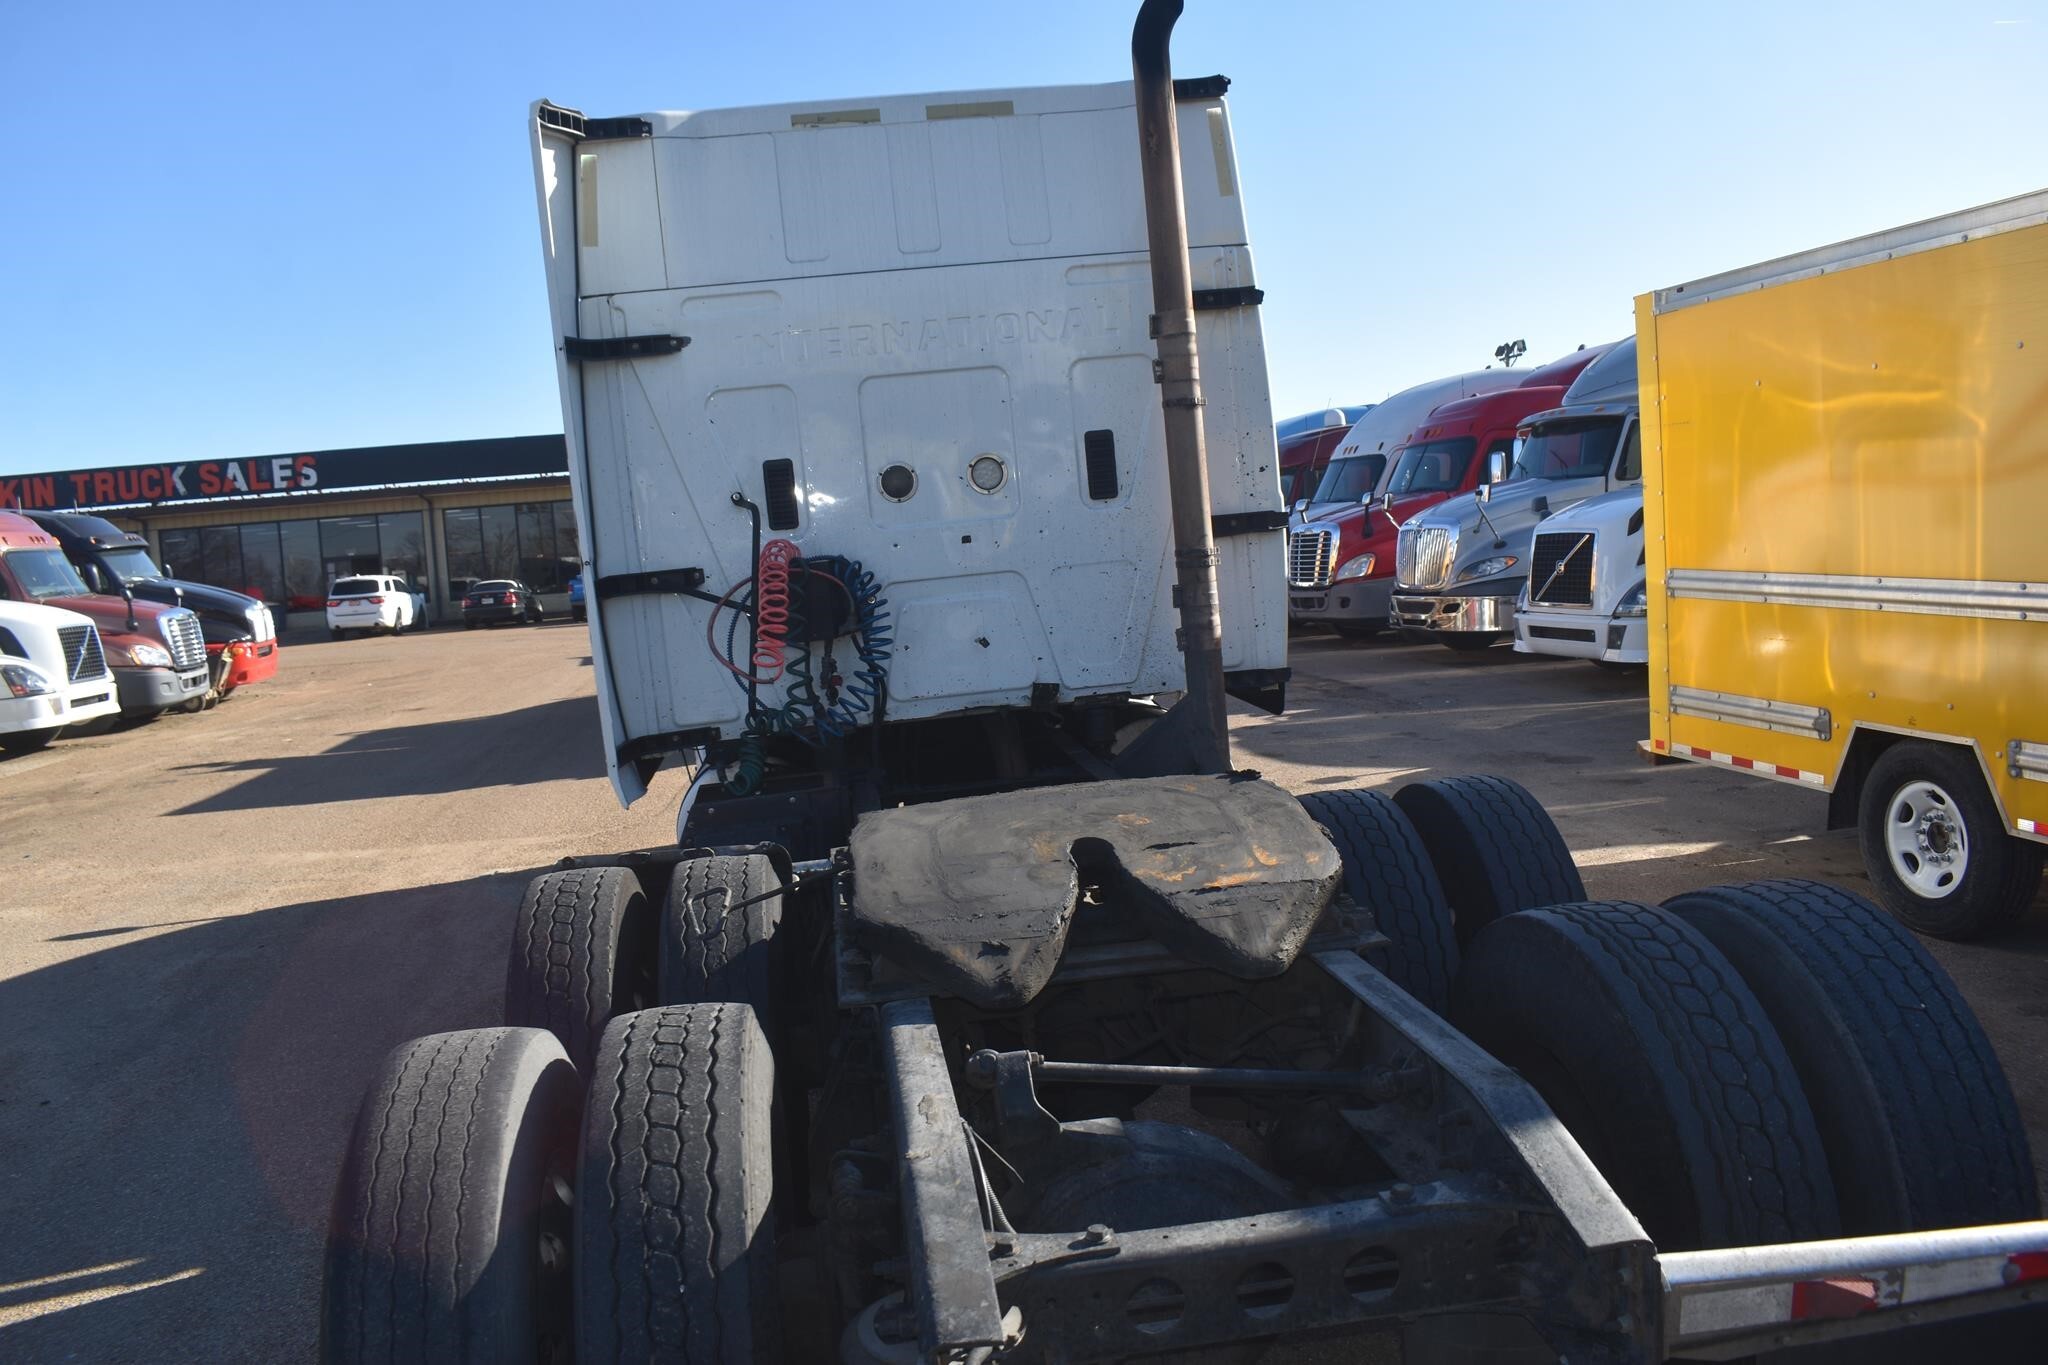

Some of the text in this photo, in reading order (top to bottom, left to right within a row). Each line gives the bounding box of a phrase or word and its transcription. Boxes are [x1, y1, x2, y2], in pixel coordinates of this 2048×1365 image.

[734, 304, 1121, 366] INTERNATIONAL
[70, 464, 187, 503] TRUCK
[199, 455, 319, 495] SALES
